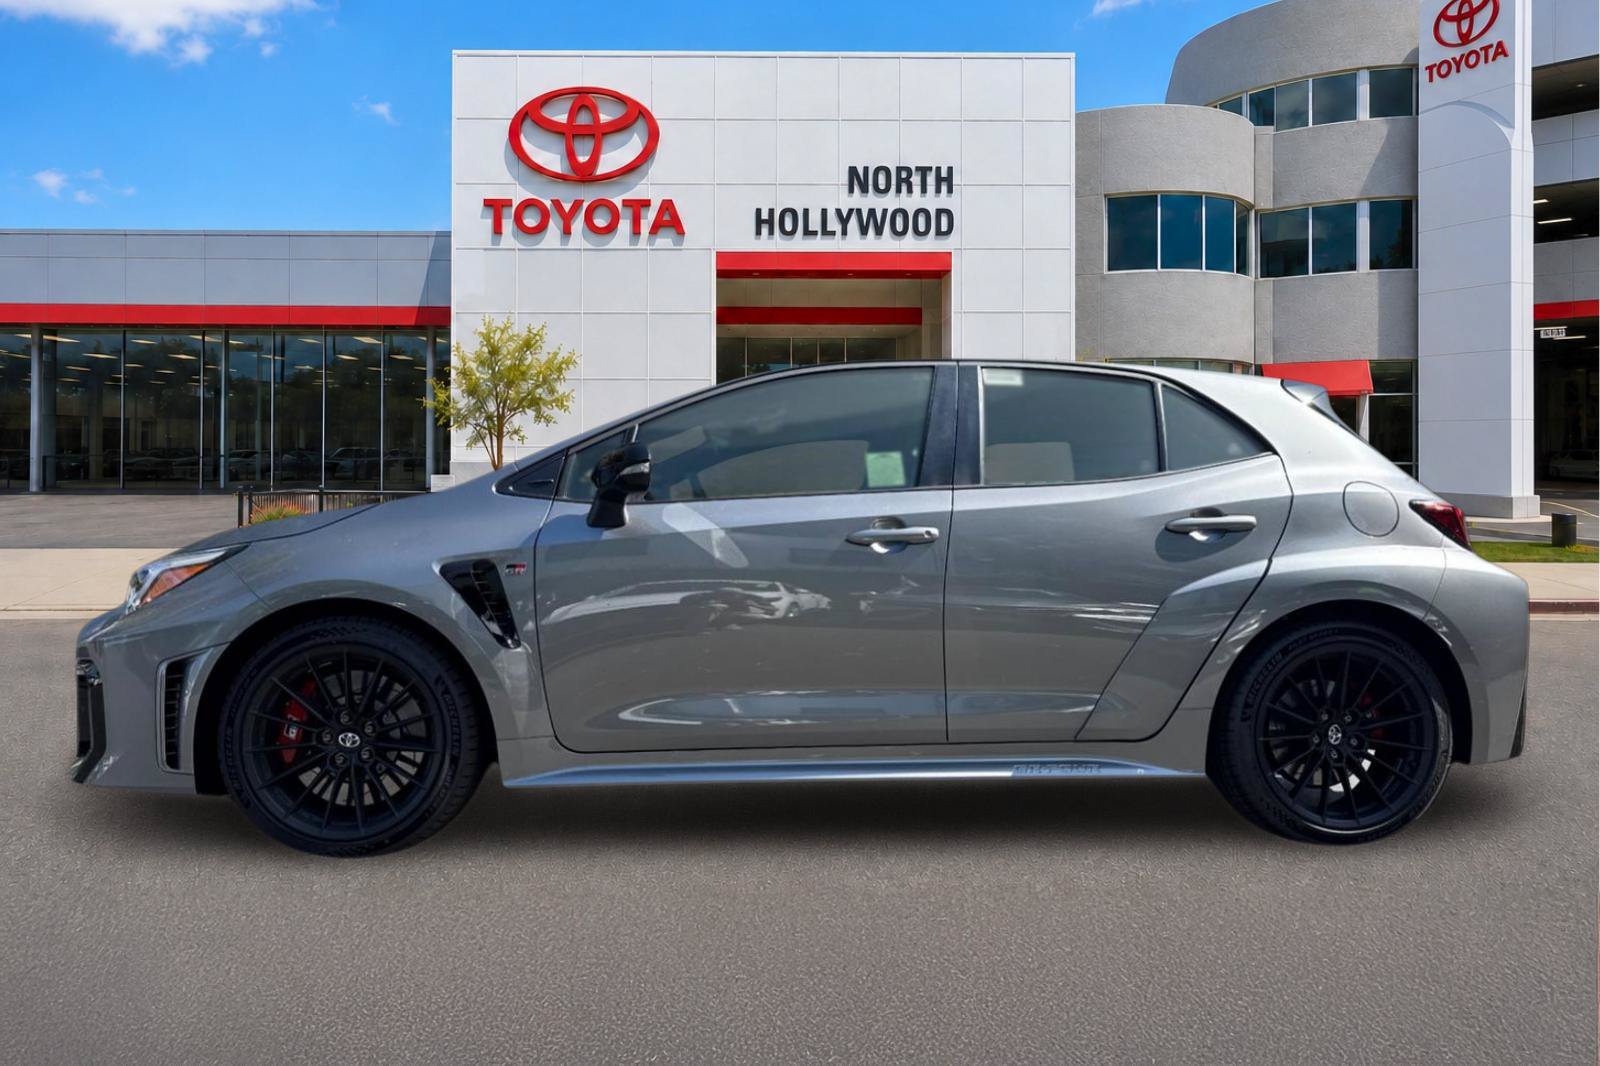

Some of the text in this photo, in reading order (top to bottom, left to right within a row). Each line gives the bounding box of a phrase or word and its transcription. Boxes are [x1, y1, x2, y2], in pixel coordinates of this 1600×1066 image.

[1425, 40, 1508, 83] TOYOTA
[848, 165, 953, 195] NORTH
[484, 198, 684, 235] TOYOTA
[755, 207, 954, 237] HOLLYWOOD
